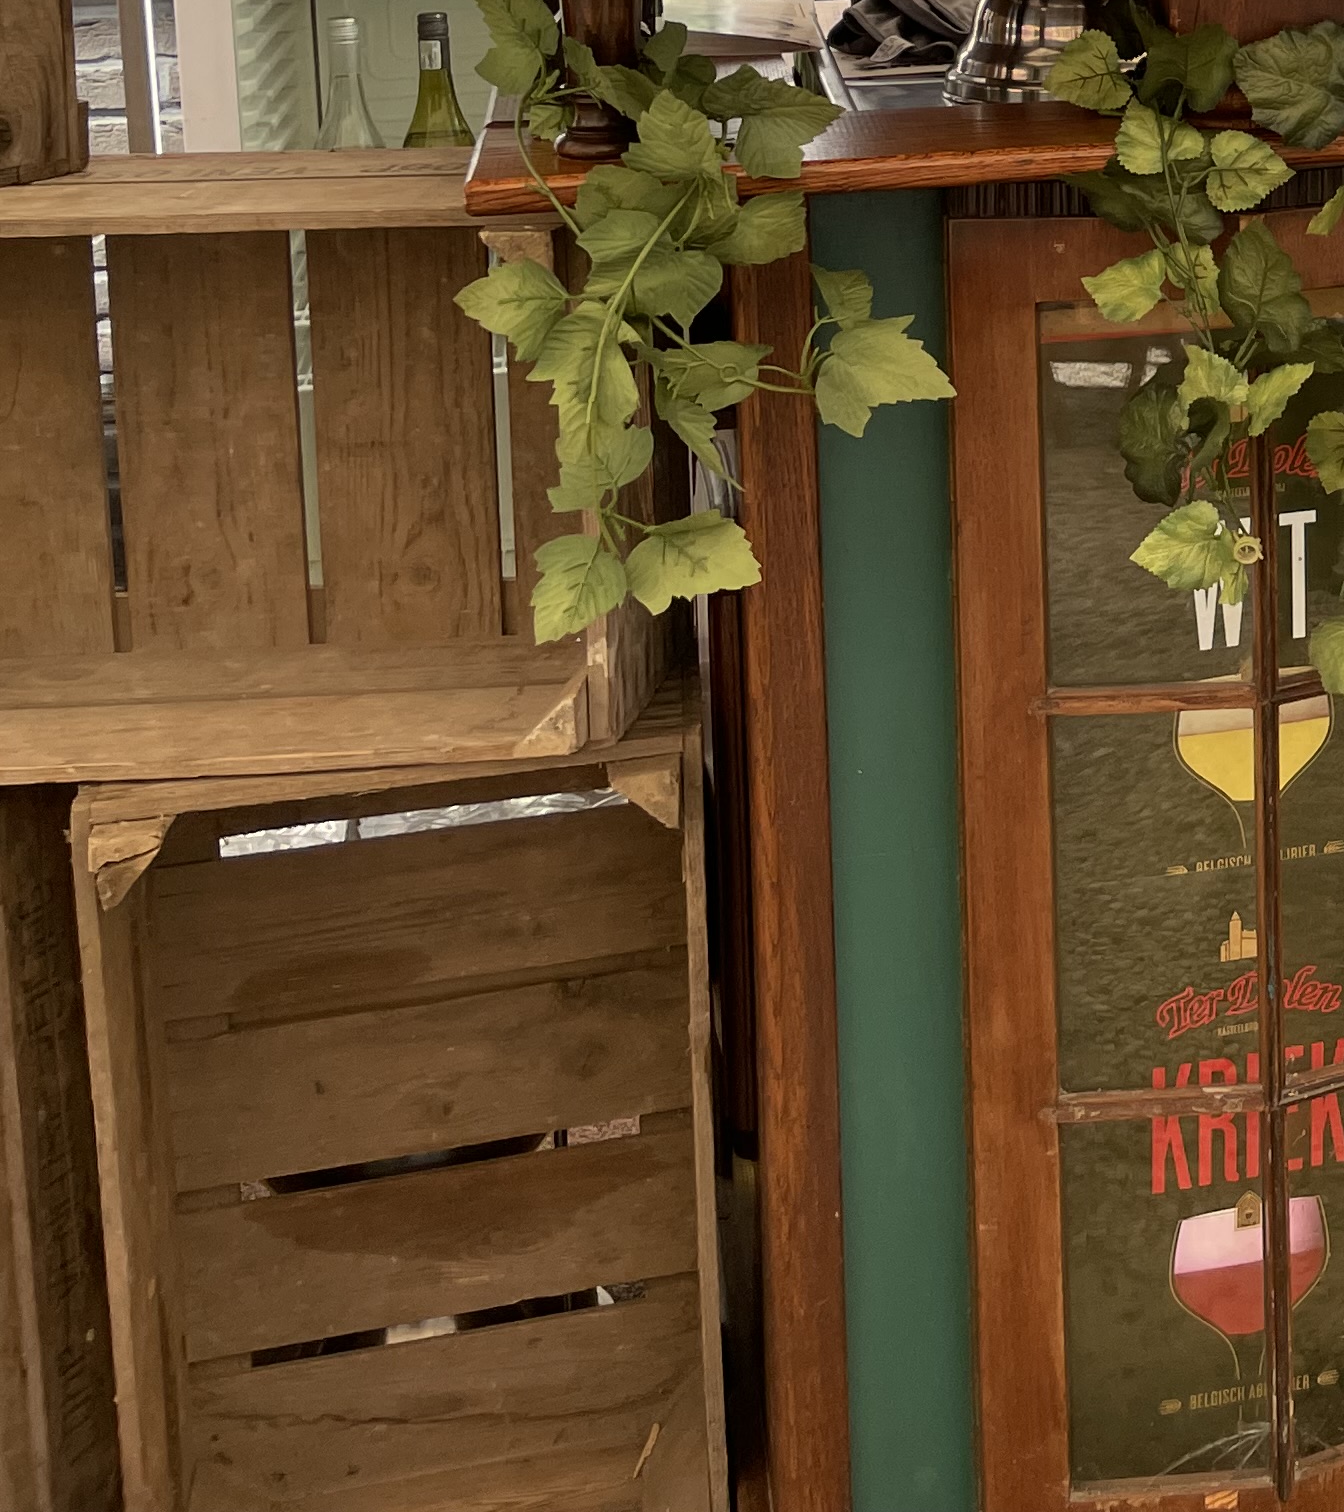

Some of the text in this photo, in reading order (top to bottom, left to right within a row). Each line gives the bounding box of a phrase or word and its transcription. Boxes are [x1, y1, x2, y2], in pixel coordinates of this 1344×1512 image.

[1193, 509, 1317, 651] WT
[1156, 965, 1343, 1039] Ter Dlen
[1189, 1385, 1245, 1411] BELGISCH
